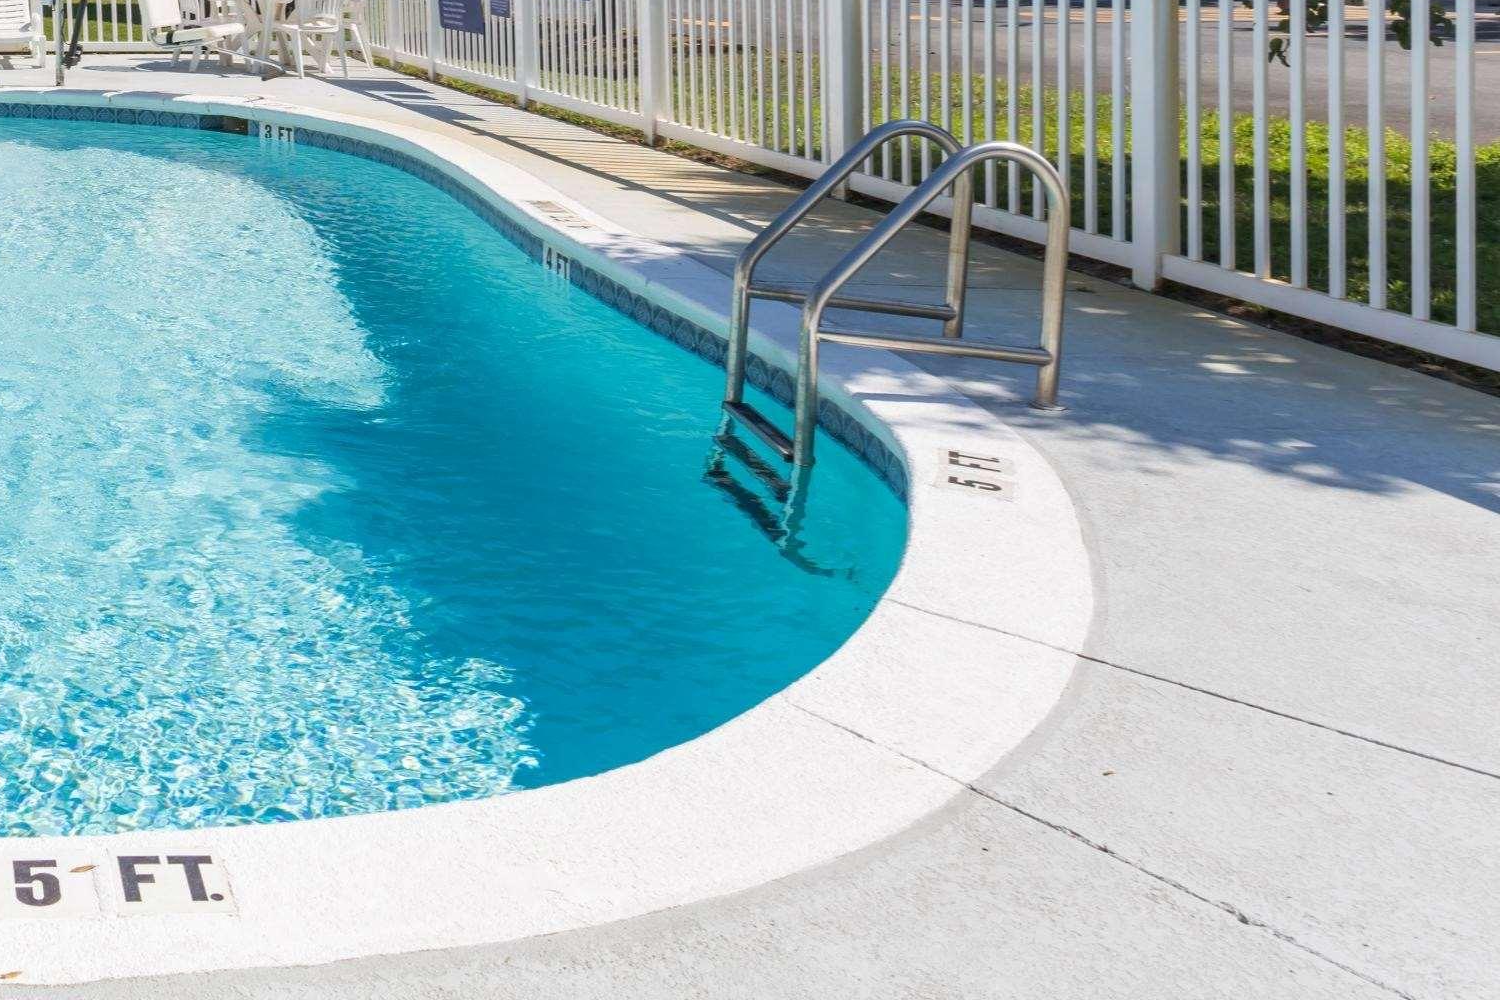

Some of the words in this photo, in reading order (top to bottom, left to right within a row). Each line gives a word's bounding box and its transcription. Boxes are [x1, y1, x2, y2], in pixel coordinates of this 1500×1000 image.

[264, 124, 273, 139] 3
[278, 126, 293, 143] FT
[947, 475, 1003, 492] 5
[13, 859, 62, 907] 5
[116, 855, 226, 903] FT.
